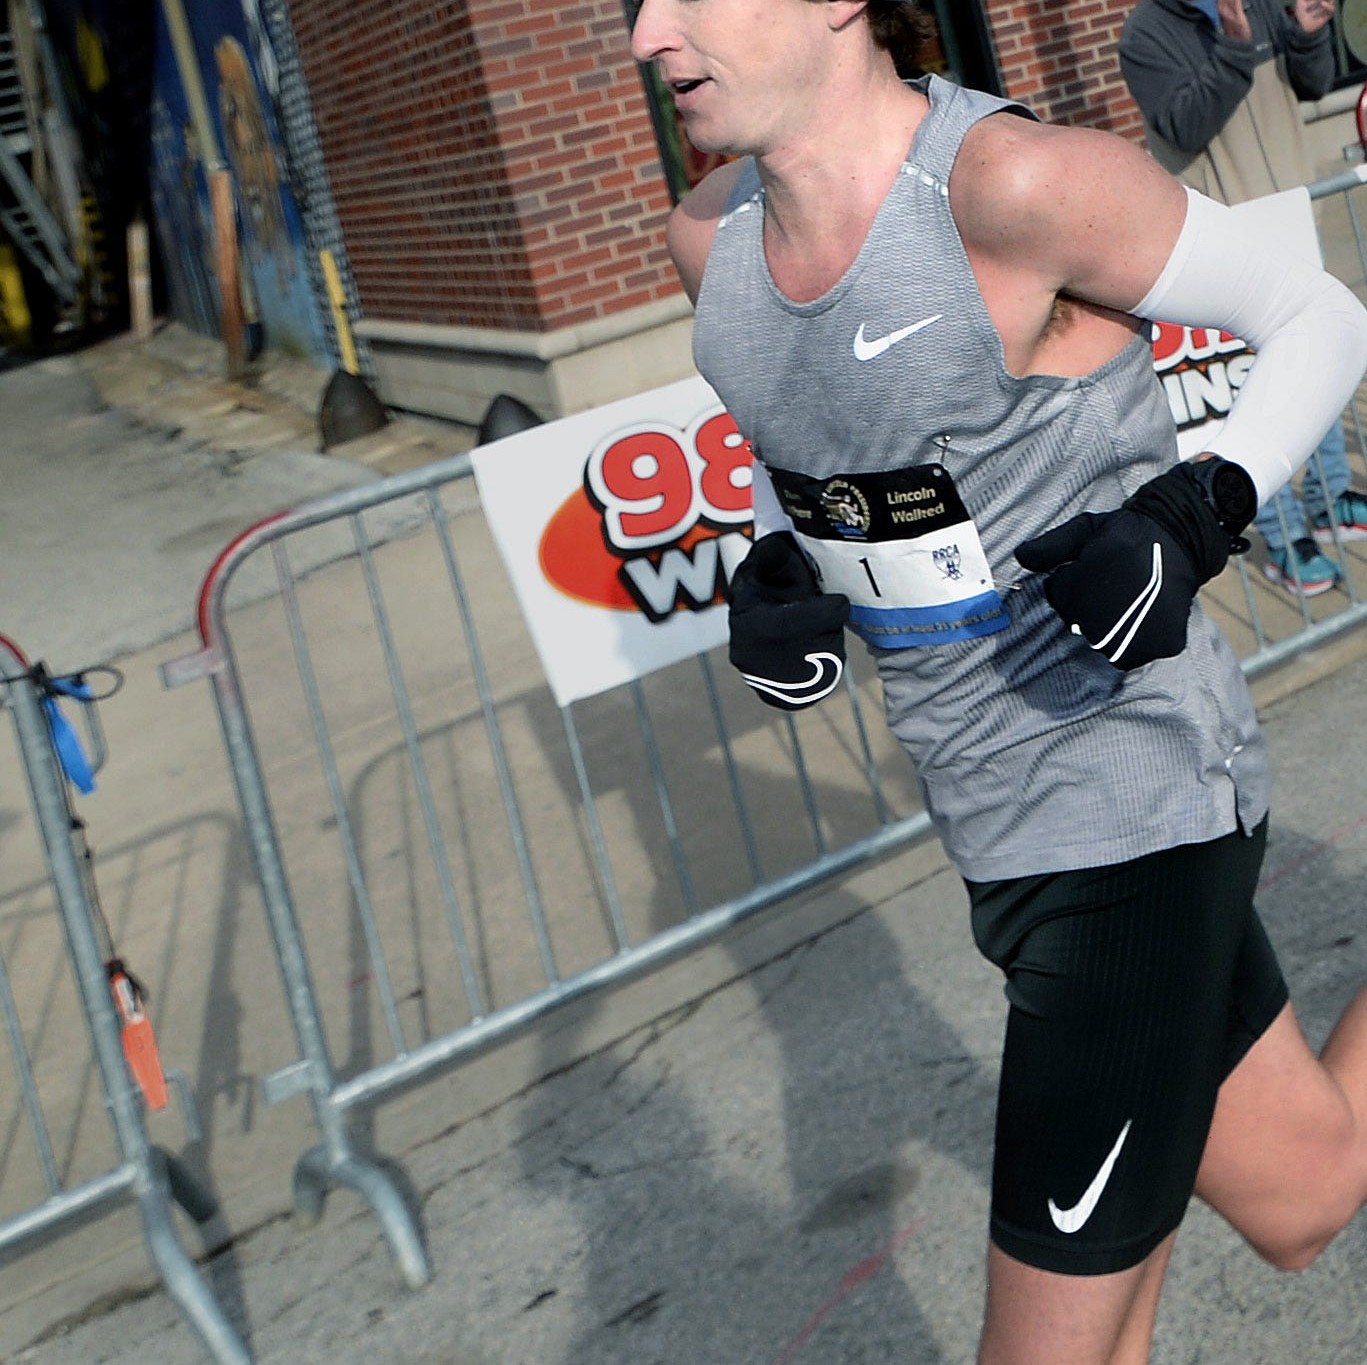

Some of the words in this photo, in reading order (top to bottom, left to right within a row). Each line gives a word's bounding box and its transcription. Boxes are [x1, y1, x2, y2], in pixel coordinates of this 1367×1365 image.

[887, 487, 936, 505] Lincoln
[891, 502, 945, 524] Walked
[932, 543, 960, 561] RRCA
[858, 557, 882, 598] 1
